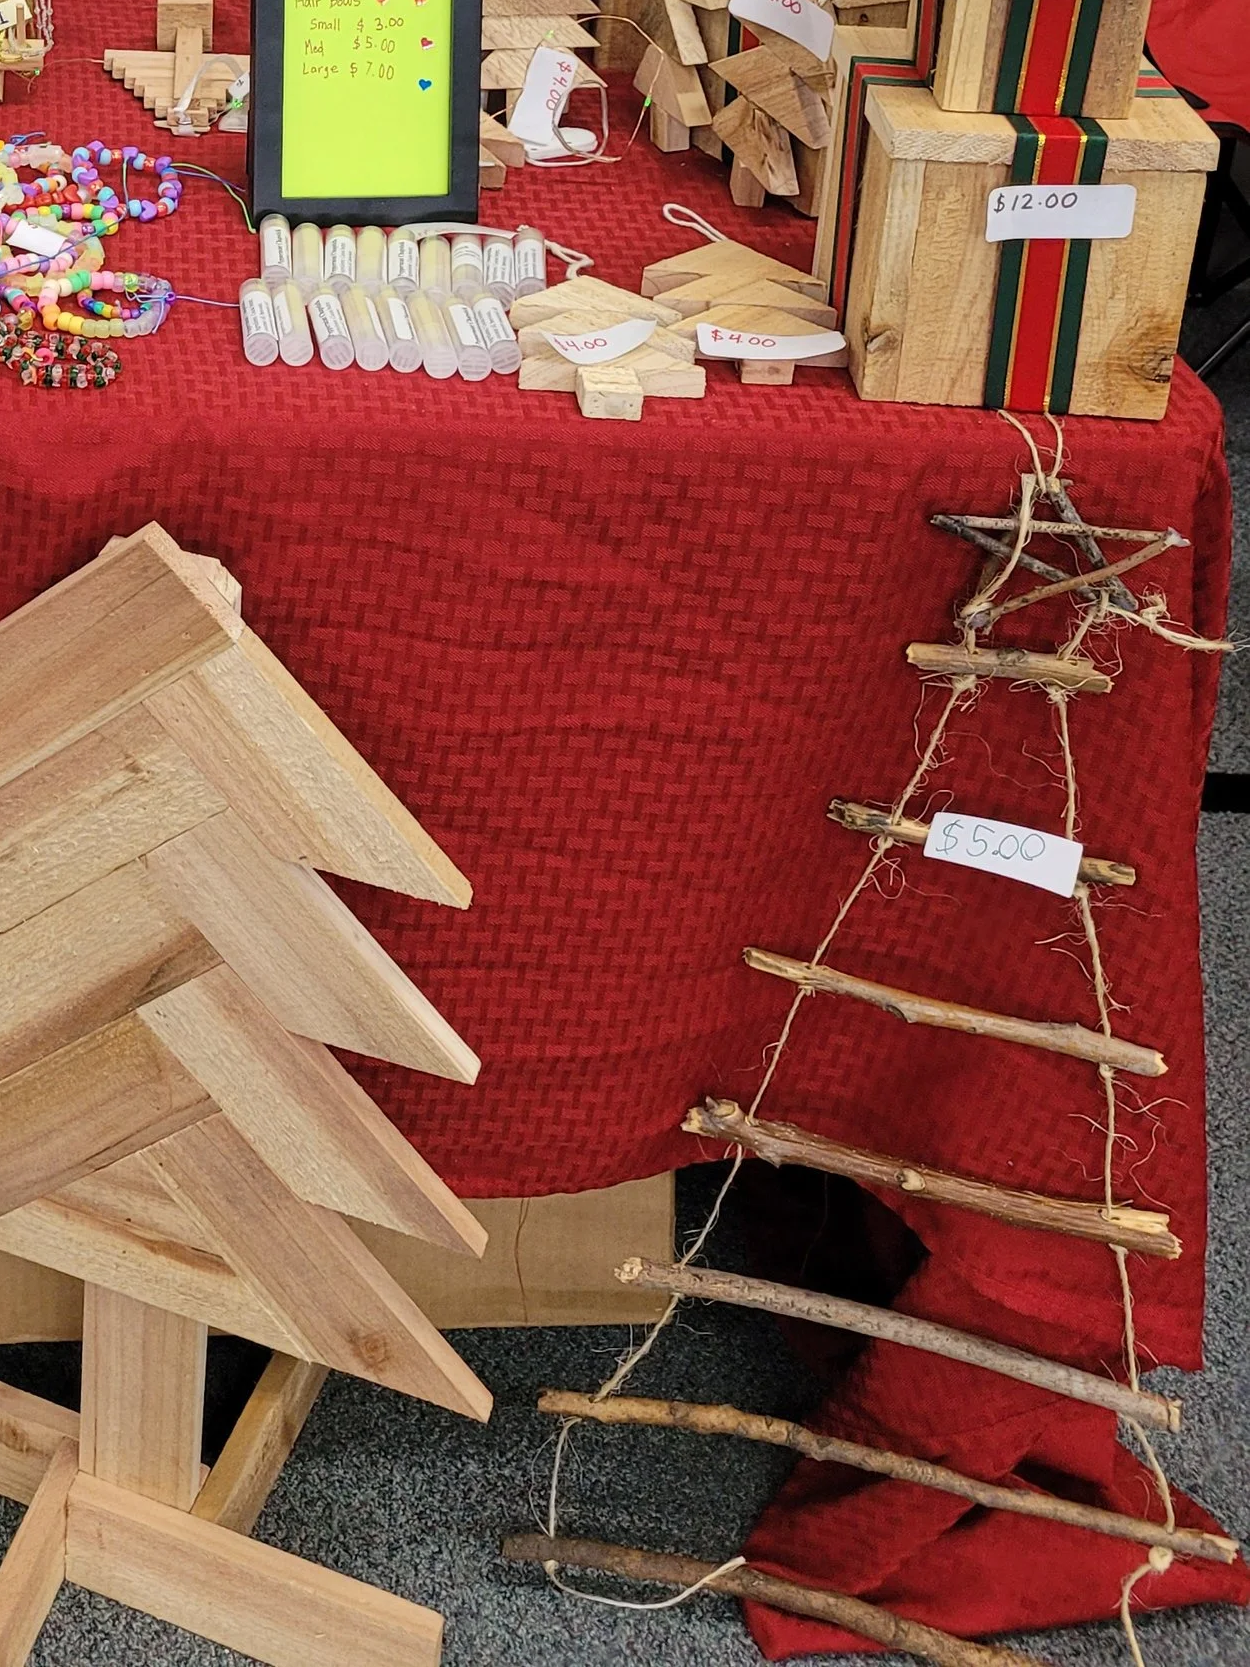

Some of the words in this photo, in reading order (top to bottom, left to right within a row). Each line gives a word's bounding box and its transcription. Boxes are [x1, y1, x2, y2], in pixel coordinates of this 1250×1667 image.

[310, 18, 341, 32] Small
[305, 39, 324, 56] Med
[302, 62, 339, 79] Large
[546, 61, 572, 111] $4.00
[993, 192, 1078, 214] $12.00
[711, 329, 776, 348] $4.00
[936, 819, 1046, 861] $5.00
